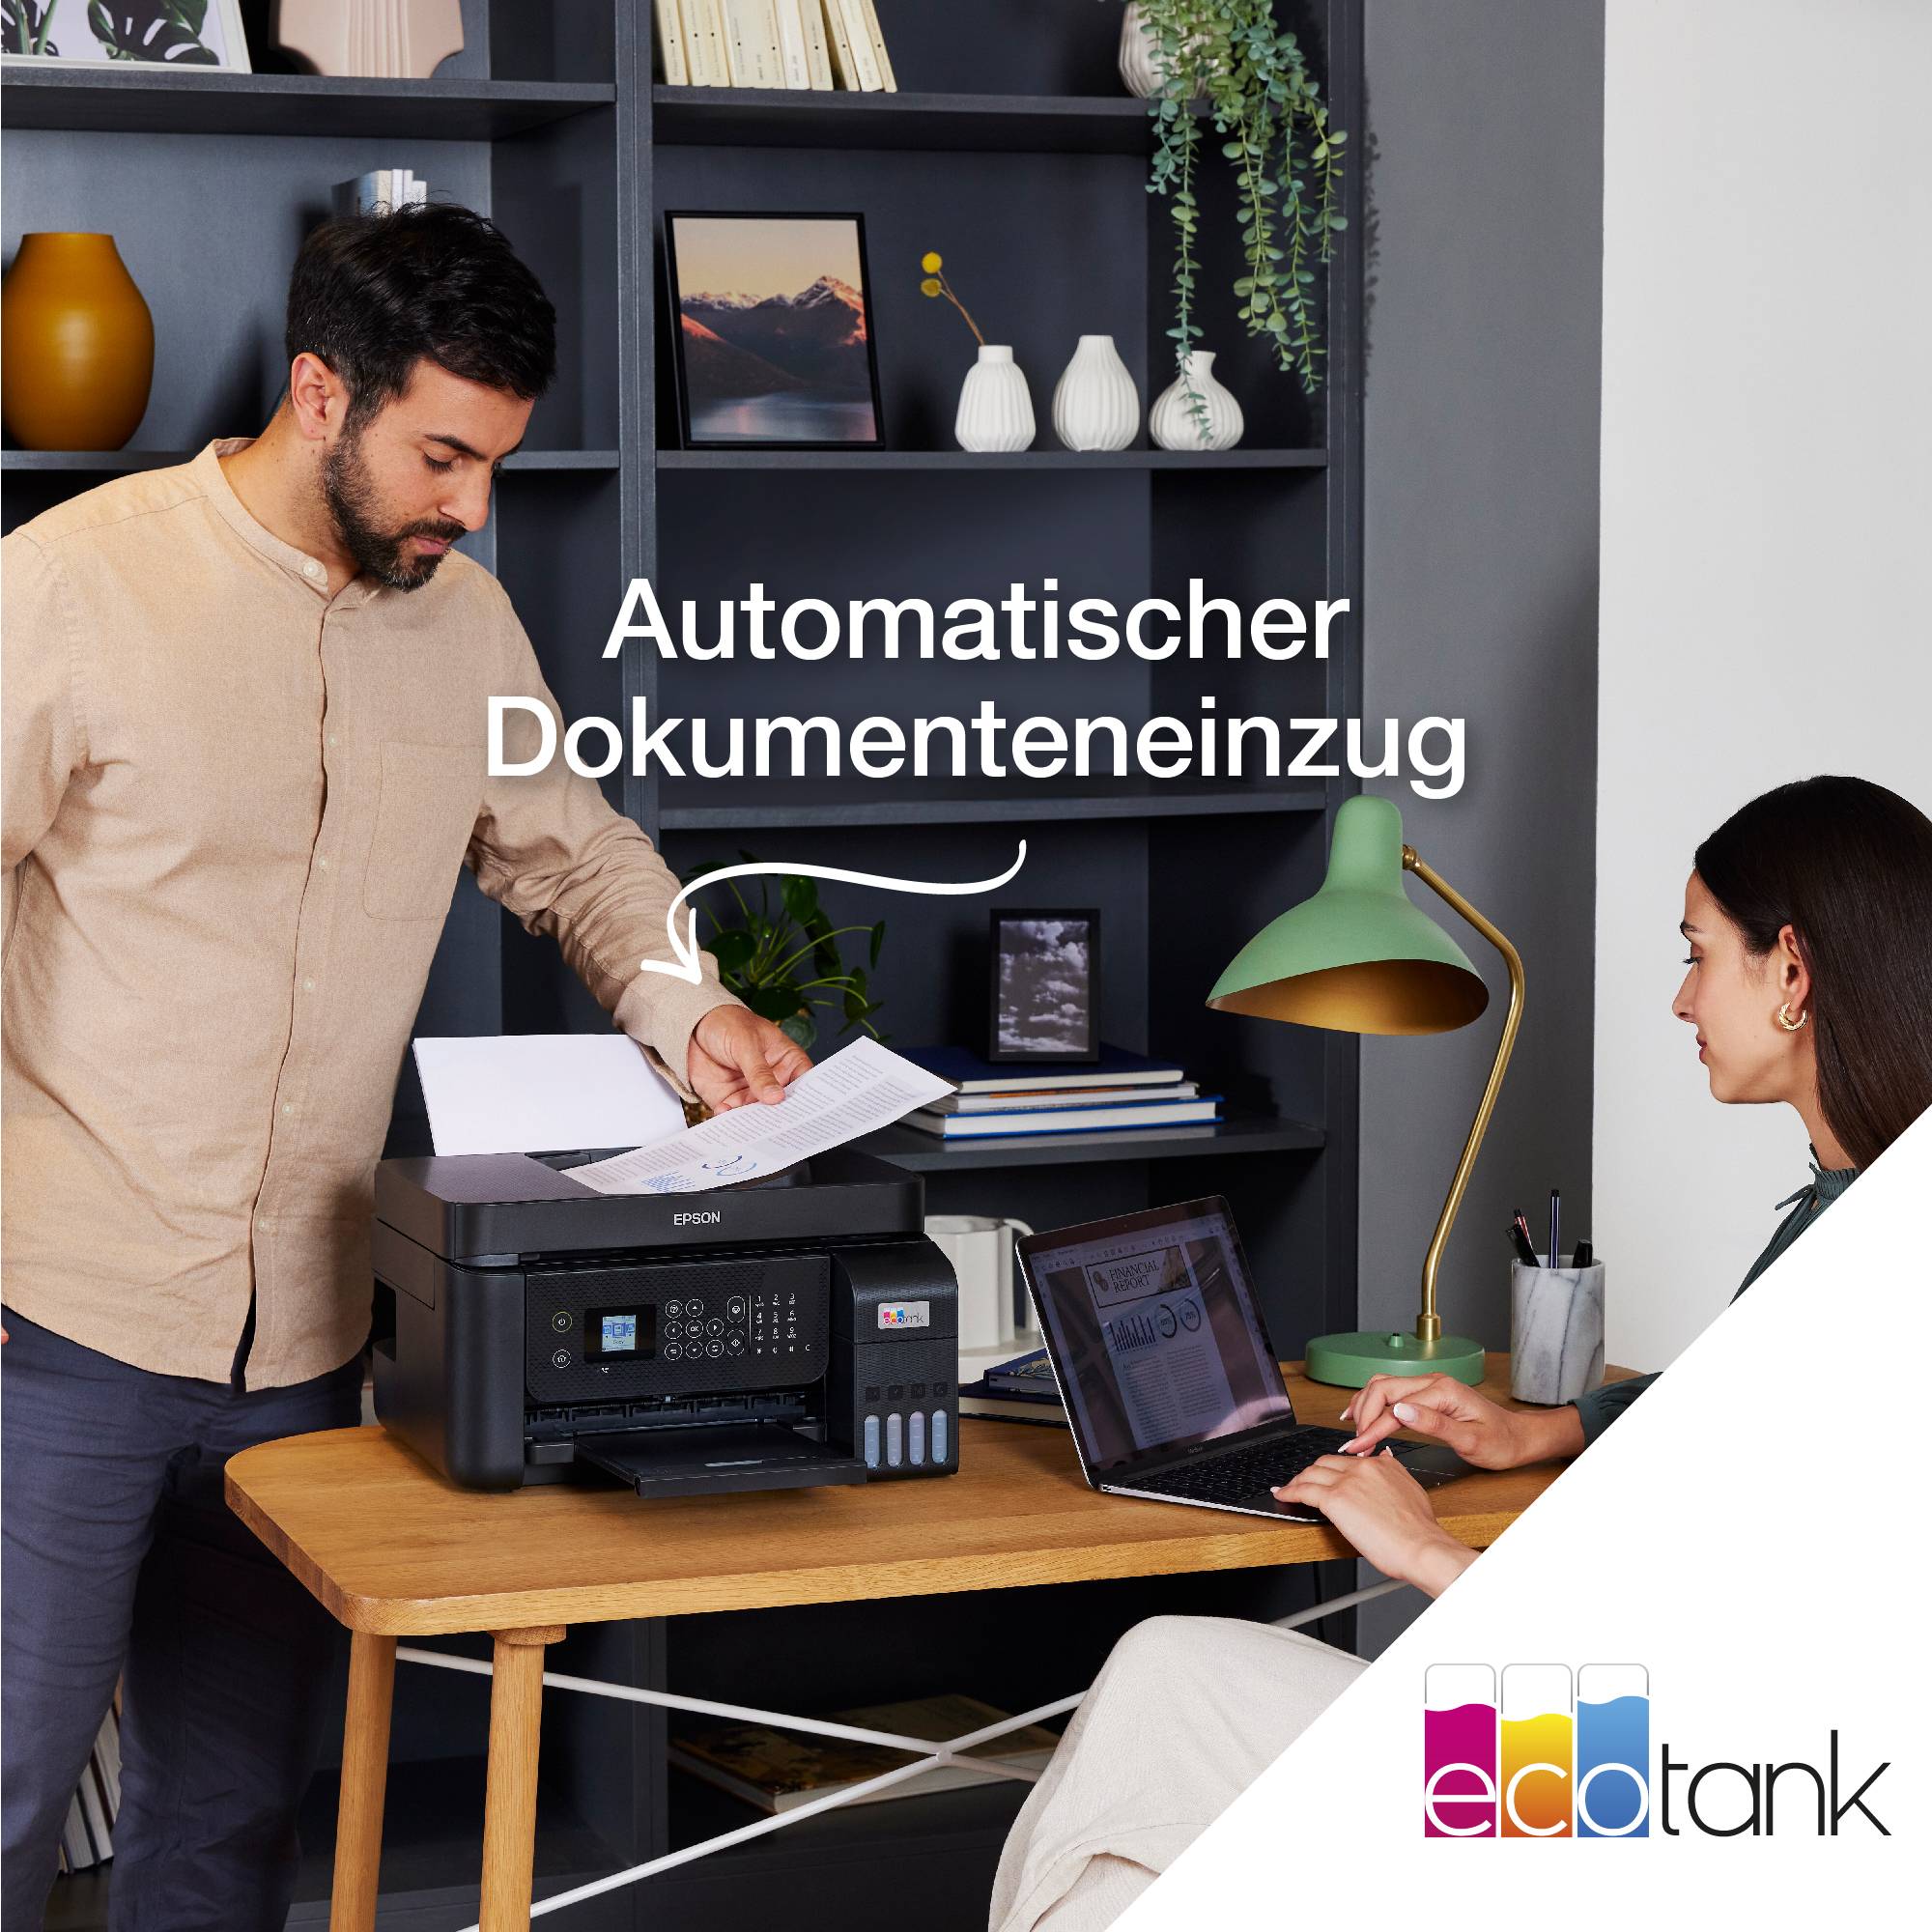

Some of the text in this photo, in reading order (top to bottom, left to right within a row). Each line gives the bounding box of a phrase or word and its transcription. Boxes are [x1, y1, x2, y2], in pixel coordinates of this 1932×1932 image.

[673, 1210, 721, 1226] EPSON
[1109, 1260, 1159, 1282] FINANCIAL
[1113, 1274, 1150, 1293] REPORT
